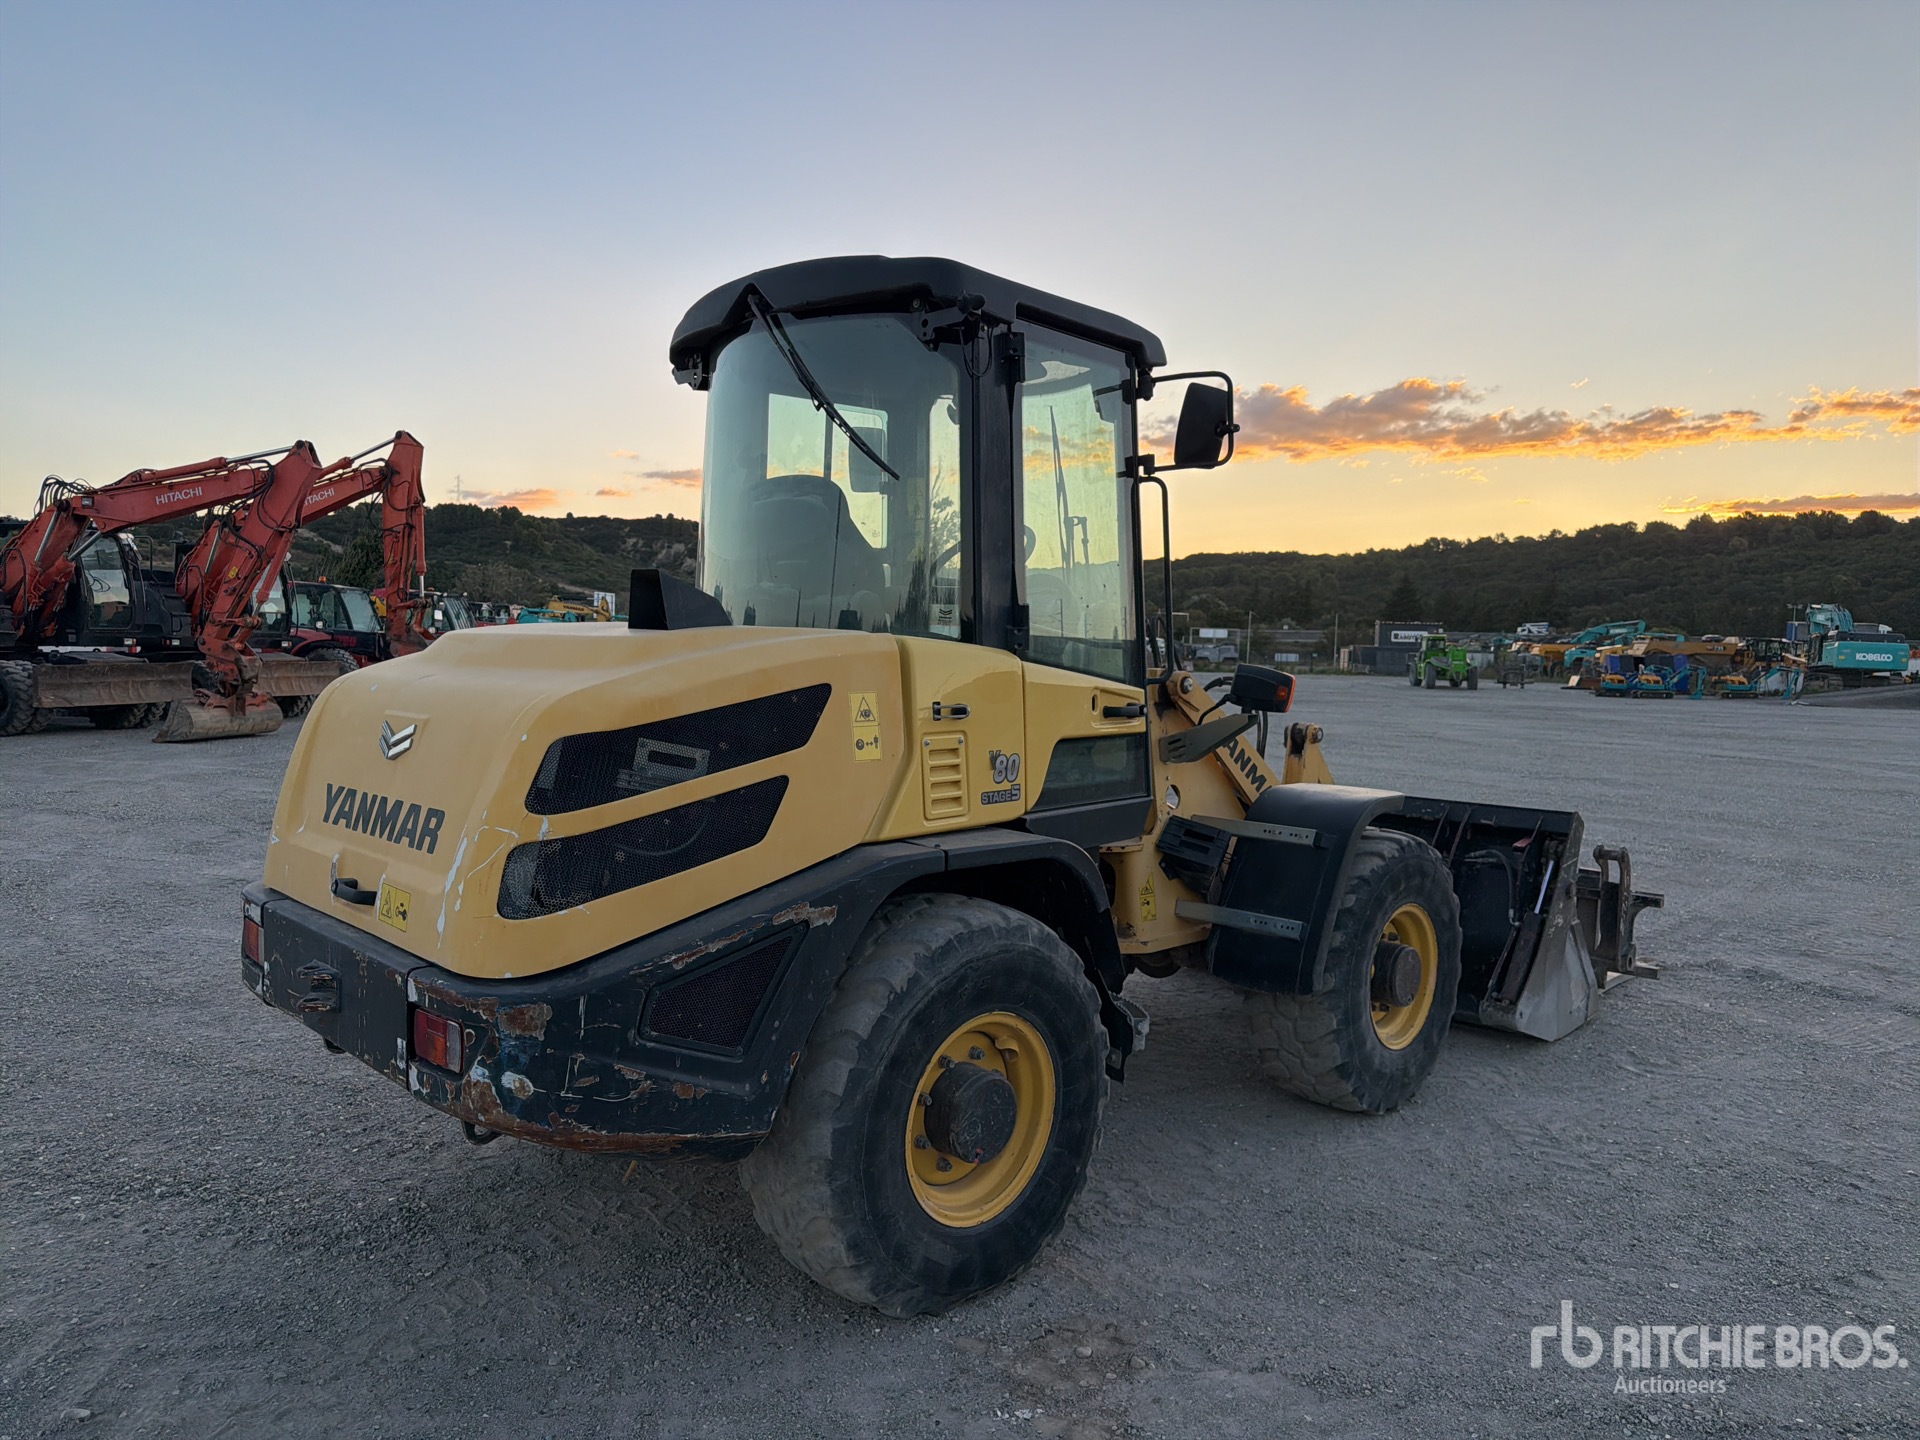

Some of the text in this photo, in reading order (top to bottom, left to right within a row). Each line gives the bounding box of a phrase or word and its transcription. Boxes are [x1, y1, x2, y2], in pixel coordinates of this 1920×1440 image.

[155, 486, 203, 505] HITACHI
[303, 488, 335, 506] ITACHI
[1855, 652, 1894, 662] KOBELCO
[322, 783, 446, 855] YANMAR
